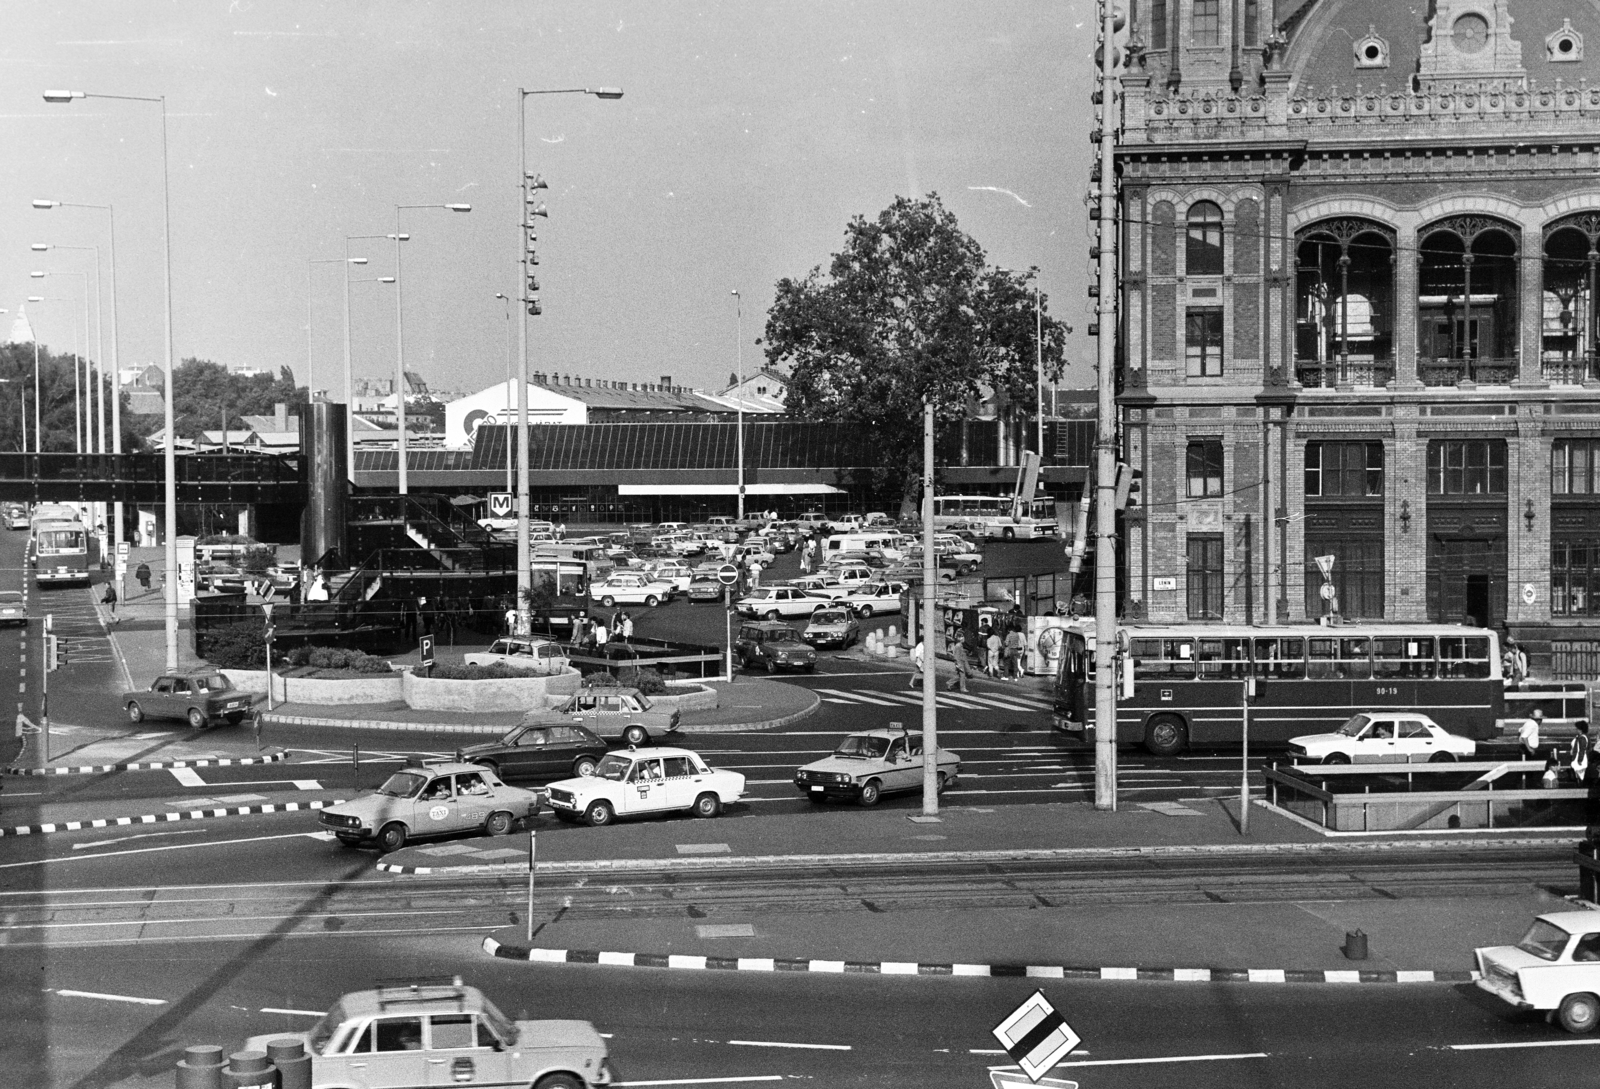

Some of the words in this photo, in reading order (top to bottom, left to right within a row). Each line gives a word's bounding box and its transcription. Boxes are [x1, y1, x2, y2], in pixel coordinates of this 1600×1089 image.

[493, 496, 510, 509] M
[423, 640, 431, 655] P
[431, 809, 447, 818] TAXI
